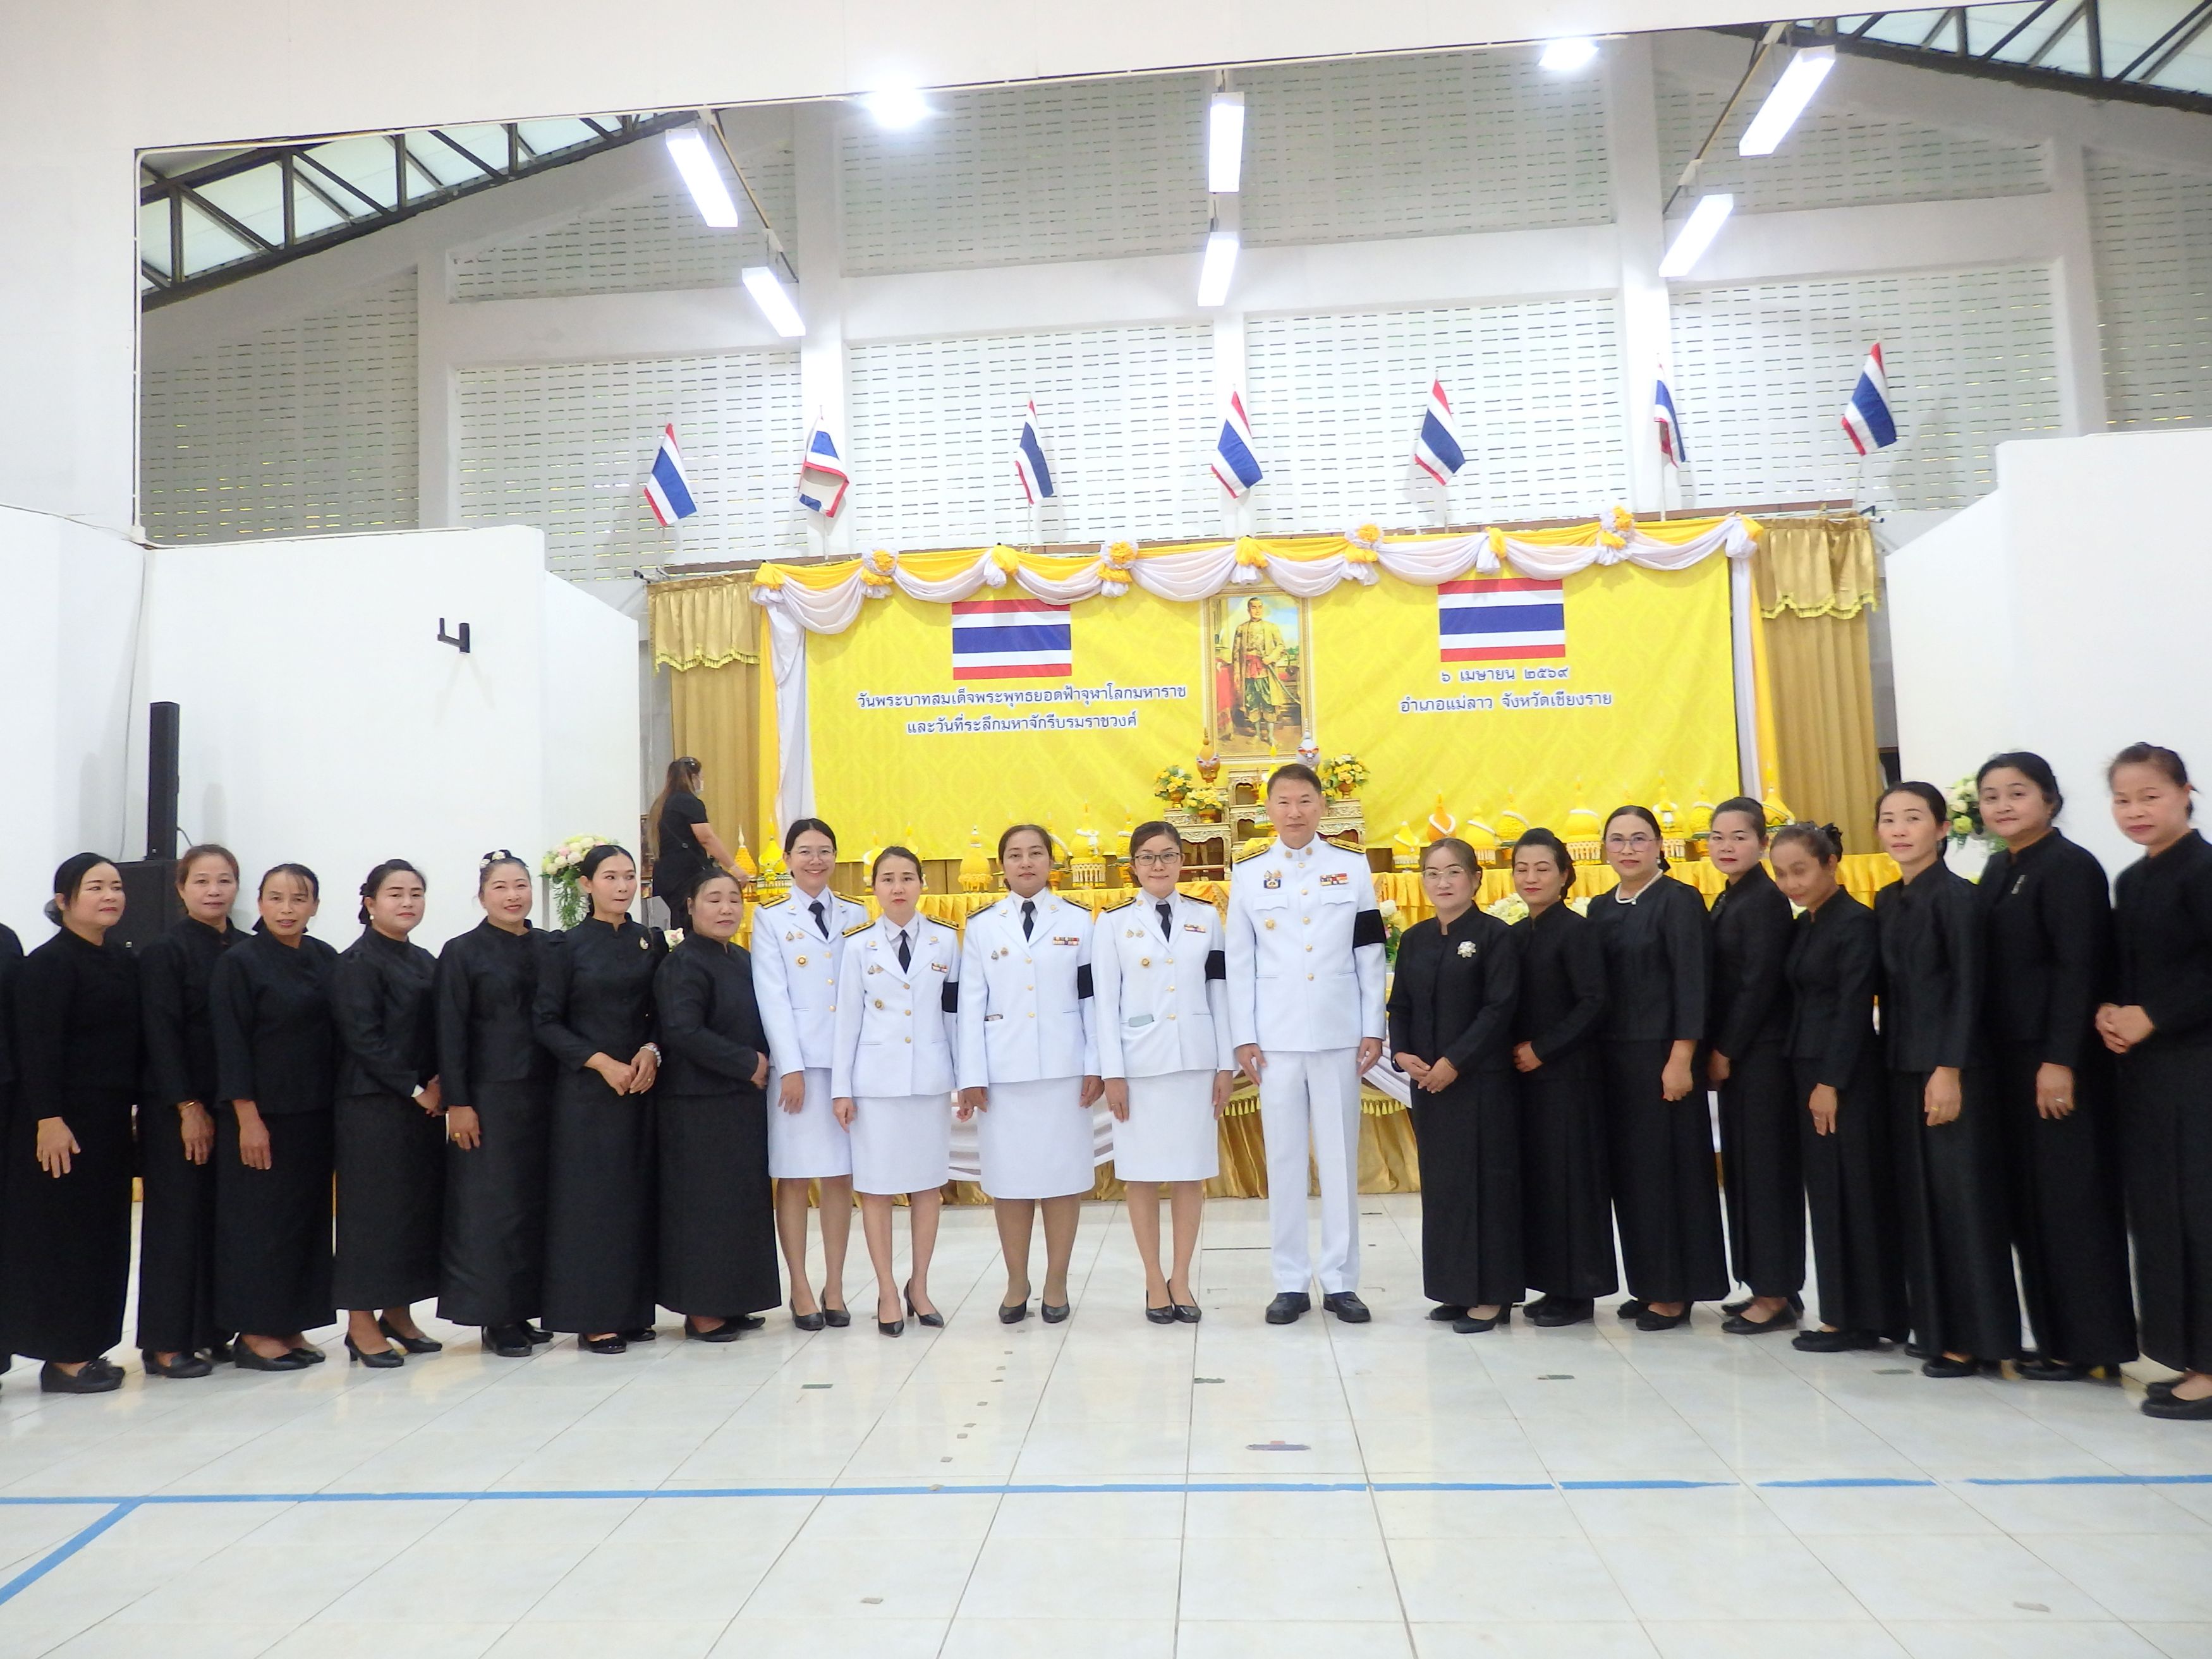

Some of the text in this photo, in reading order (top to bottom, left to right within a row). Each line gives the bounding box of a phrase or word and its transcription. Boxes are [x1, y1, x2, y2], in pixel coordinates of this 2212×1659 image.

[1442, 667, 1569, 682] ๖ เมษายน ๒๕๖๙
[857, 683, 1186, 707] วันพระบาทสมเด็จพระพุทธยอดฟ้าจุฬาโลกมหาราช
[1401, 691, 1612, 712] อำเภอแม่ลาว จังหวัดเชียงราย
[908, 710, 1136, 733] และวันที่ระลึกมหาจักรีบรมราชวงศ์
